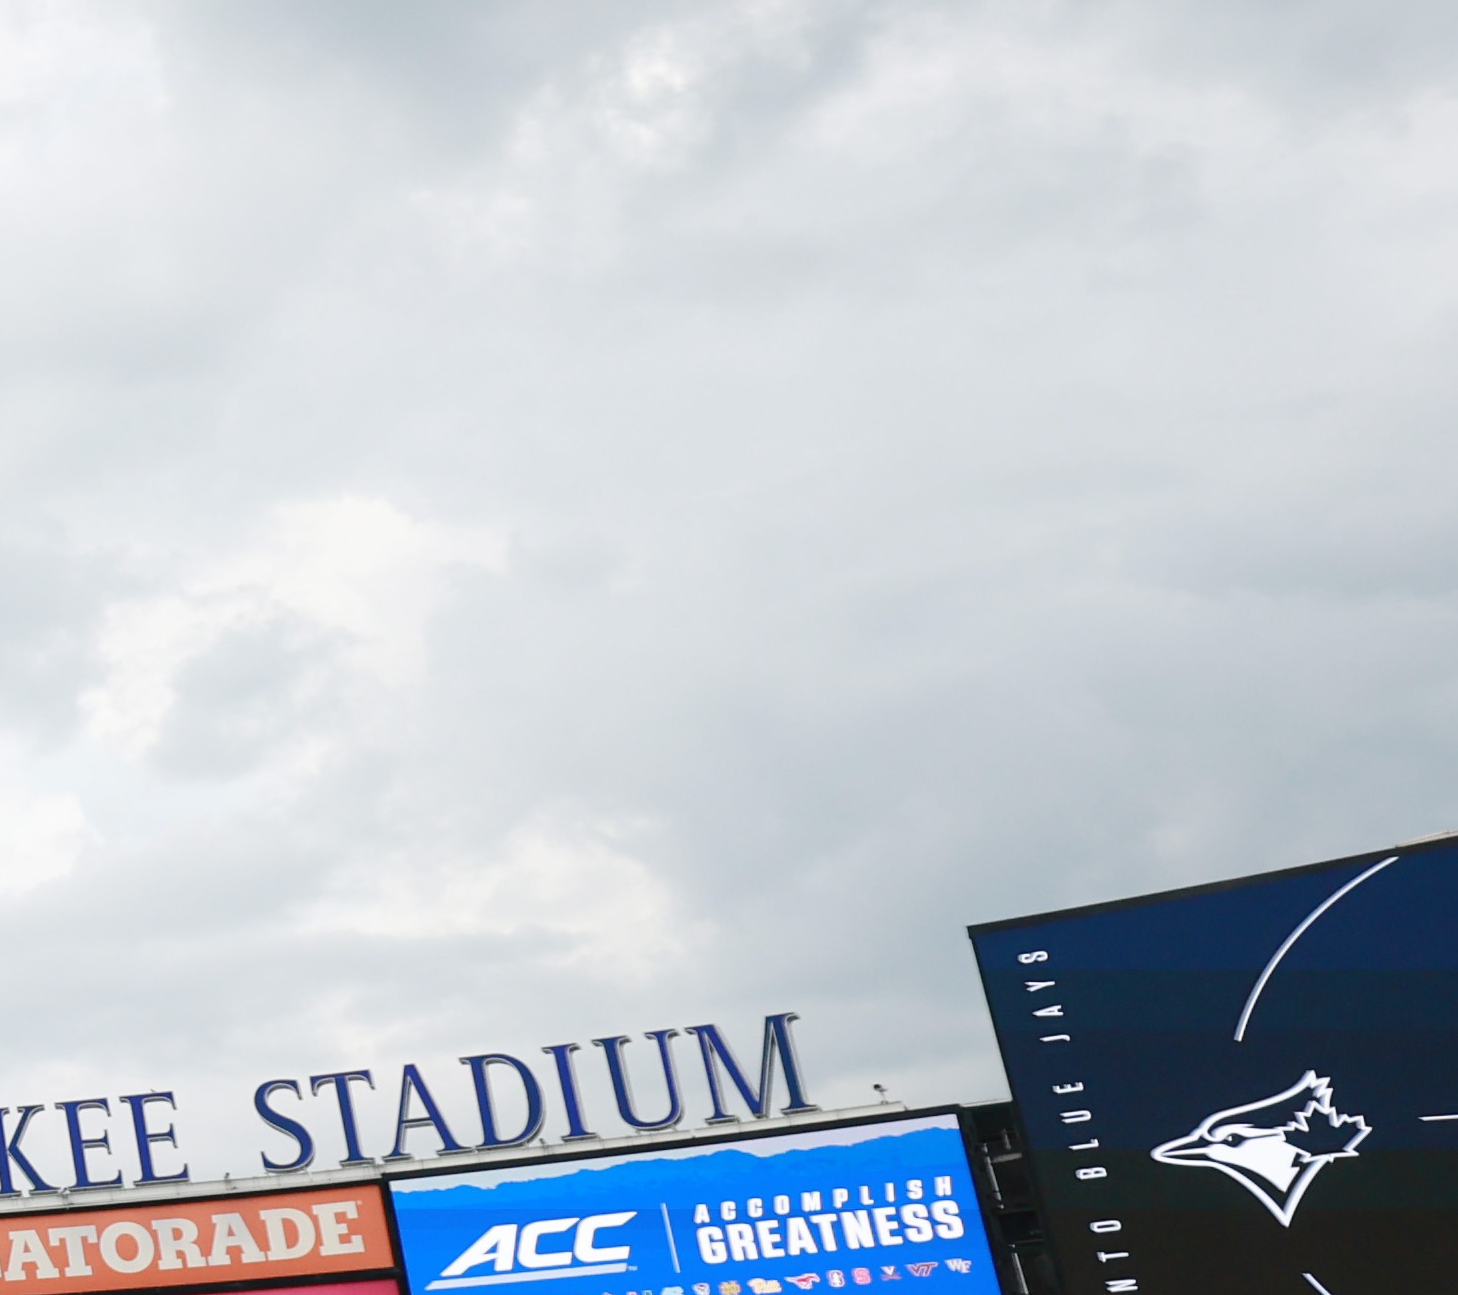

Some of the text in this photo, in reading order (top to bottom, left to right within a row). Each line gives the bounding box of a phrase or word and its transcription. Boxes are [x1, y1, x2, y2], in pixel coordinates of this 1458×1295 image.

[1018, 949, 1071, 1044] JAYS
[253, 1012, 821, 1173] STADIUM
[1052, 1080, 1108, 1180] BLUE
[694, 1175, 953, 1224] ACCOMPLISH
[697, 1202, 964, 1265] GREATNESS
[440, 1211, 637, 1277] ACC
